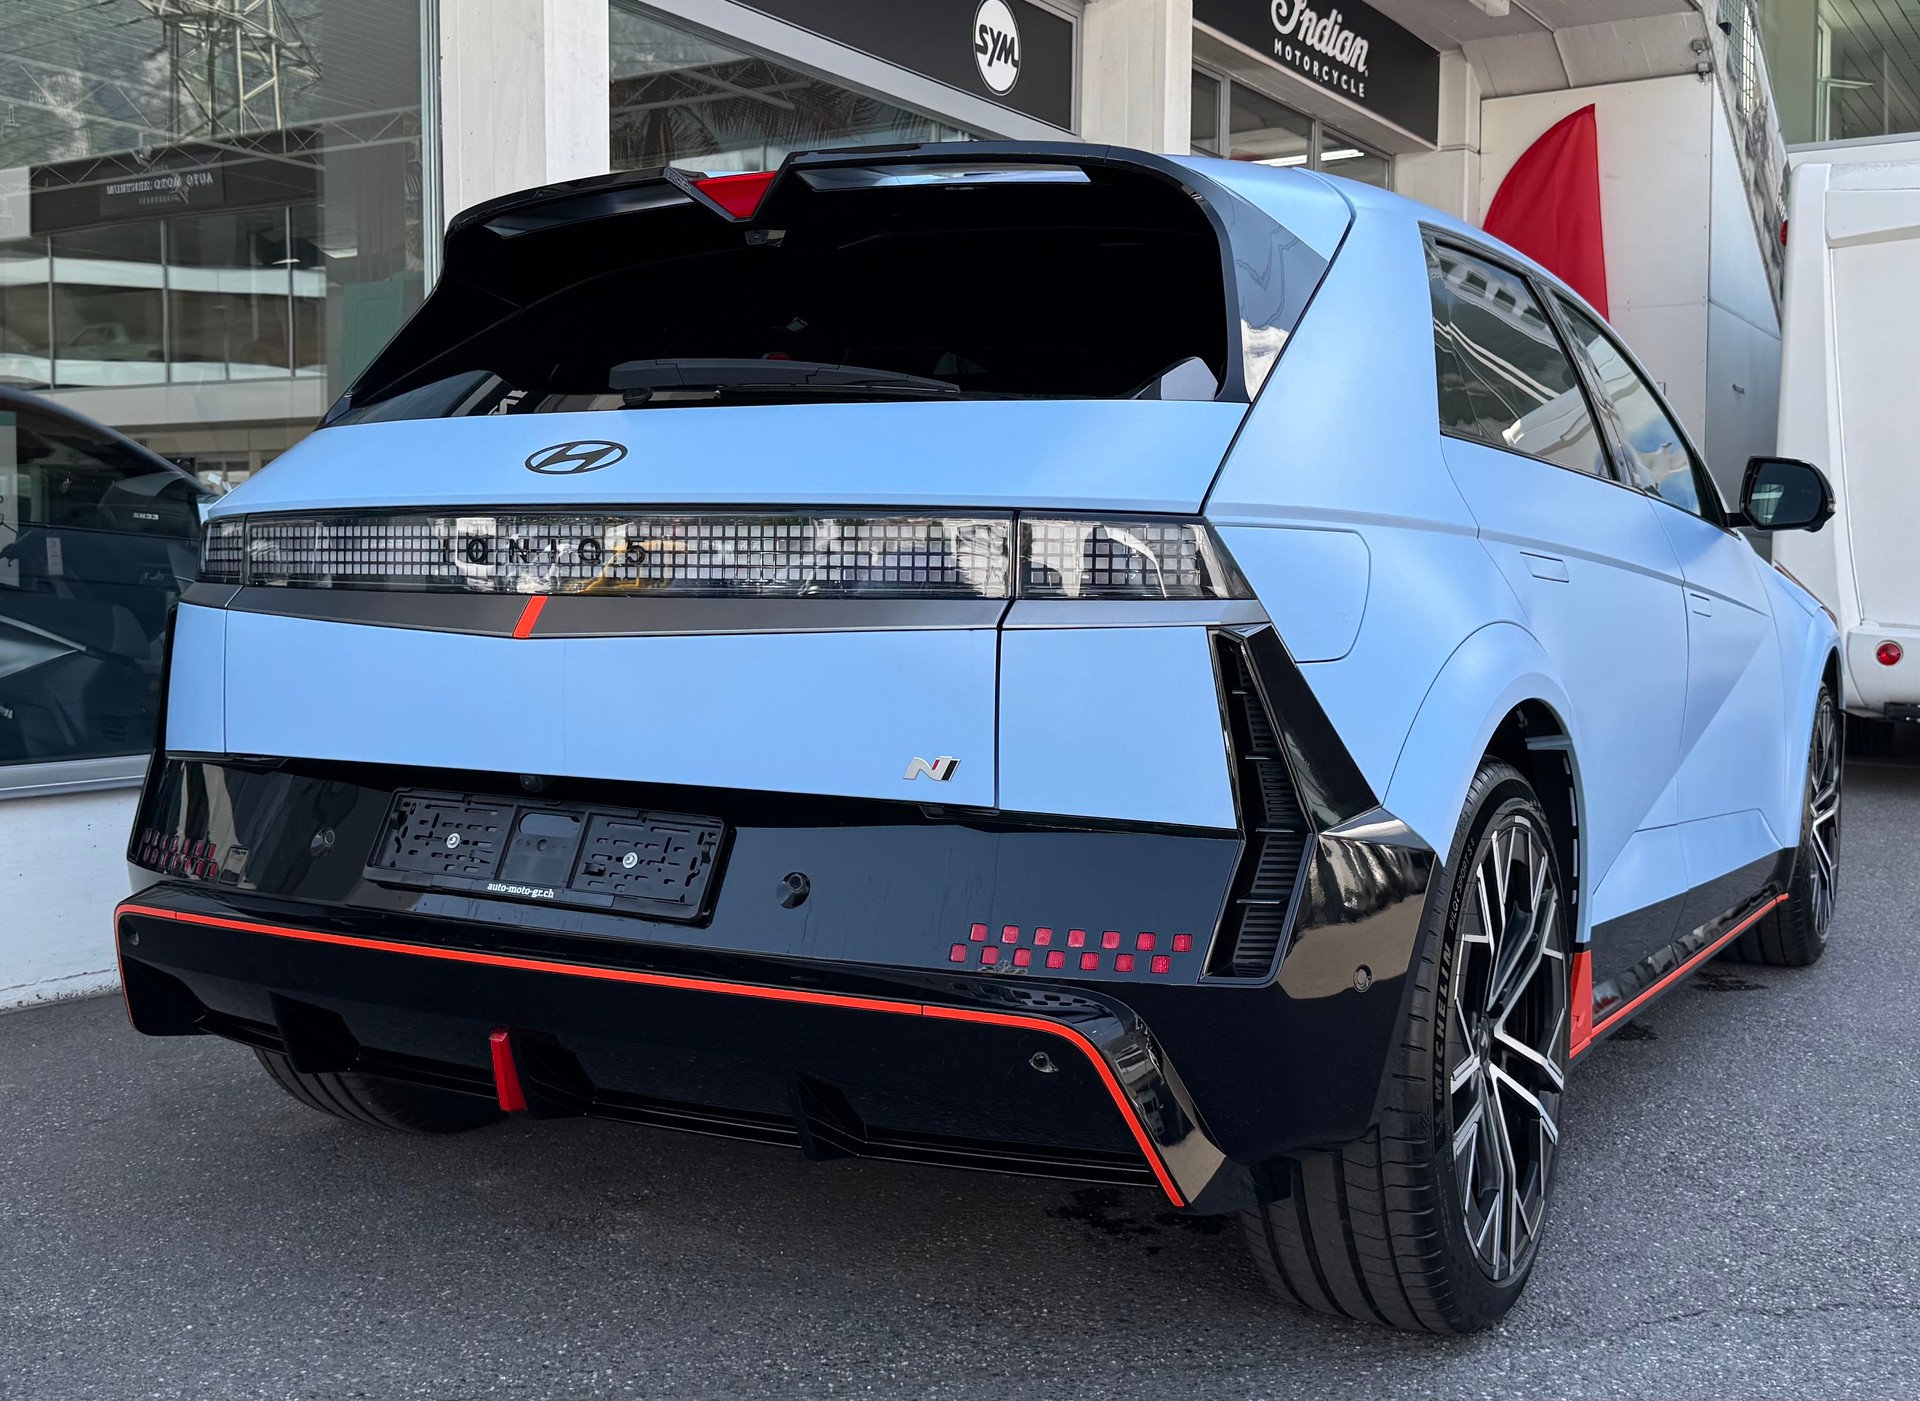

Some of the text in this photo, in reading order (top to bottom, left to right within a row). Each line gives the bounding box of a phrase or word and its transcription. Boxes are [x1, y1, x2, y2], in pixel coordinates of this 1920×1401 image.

[975, 24, 1019, 68] SYM
[1271, 0, 1369, 73] Indian
[1274, 38, 1365, 98] MOTORCYCLE
[487, 883, 555, 899] auto-moto-gr.ch
[1449, 892, 1460, 931] PILOT
[1434, 943, 1452, 1101] MICHELIN
